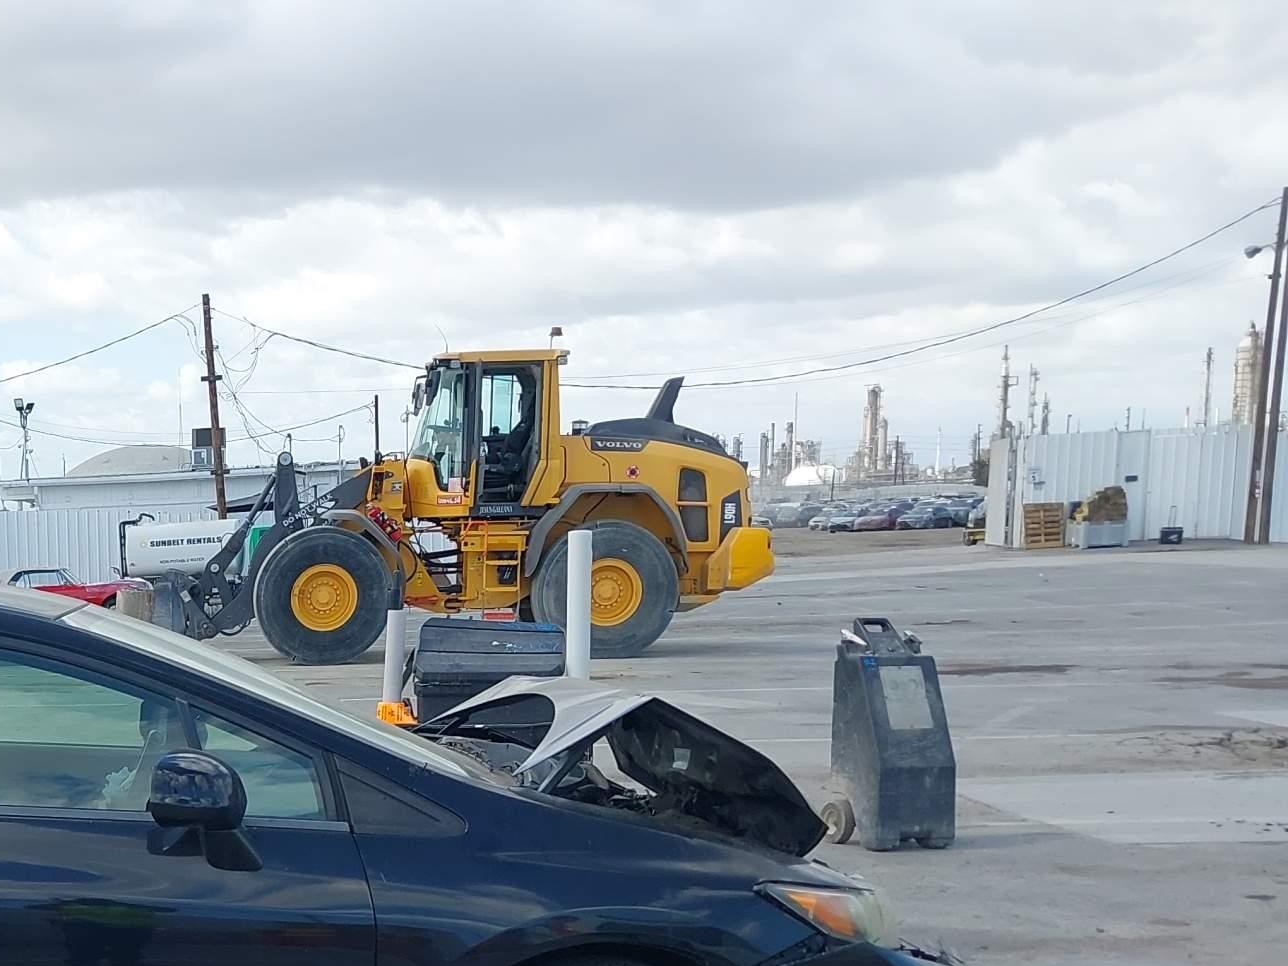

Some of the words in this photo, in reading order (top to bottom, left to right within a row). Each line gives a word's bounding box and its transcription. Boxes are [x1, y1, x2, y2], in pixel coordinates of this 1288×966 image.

[282, 516, 295, 527] DO
[310, 493, 333, 512] WALK
[723, 502, 736, 524] L90H
[150, 538, 185, 548] SUNBELT
[186, 536, 222, 545] RENTALS
